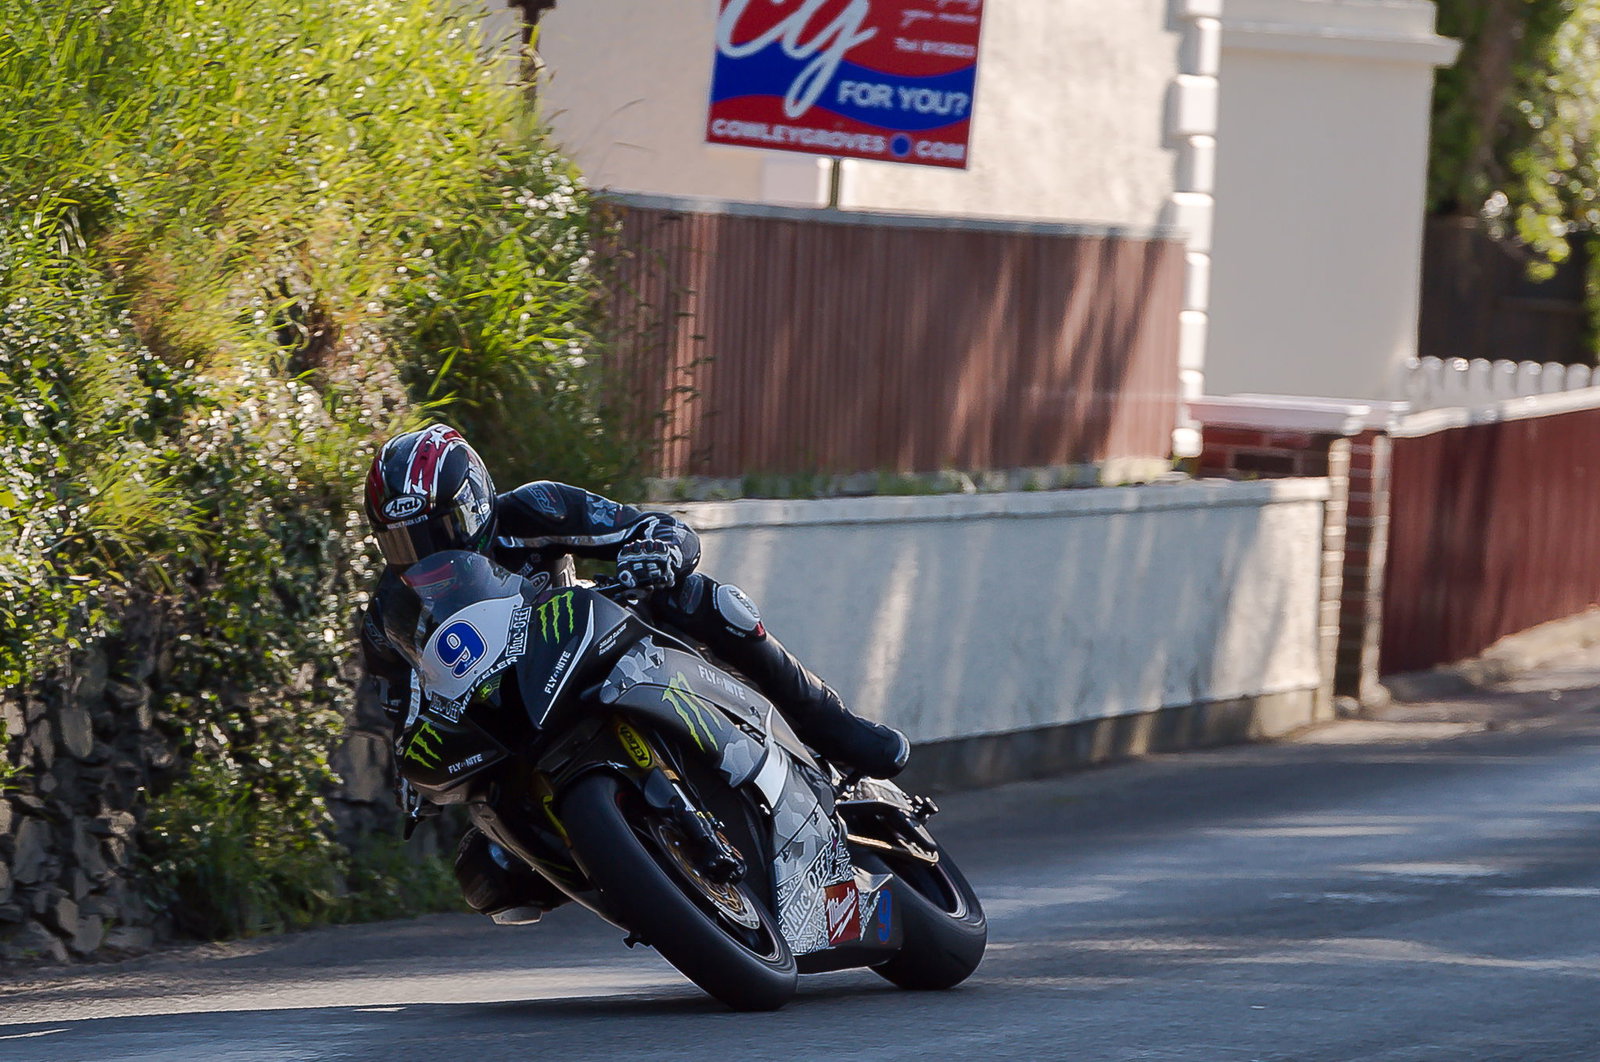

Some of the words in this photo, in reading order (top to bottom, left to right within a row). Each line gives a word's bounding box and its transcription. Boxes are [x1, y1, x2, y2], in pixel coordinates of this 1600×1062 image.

[838, 80, 893, 109] FOR
[898, 85, 969, 116] YOU?
[386, 496, 421, 514] Arai
[434, 619, 488, 679] 9
[544, 675, 557, 694] FLY
[555, 650, 571, 671] NITE
[697, 664, 716, 685] FLY
[447, 762, 461, 774] FLY
[877, 888, 892, 943] 9
